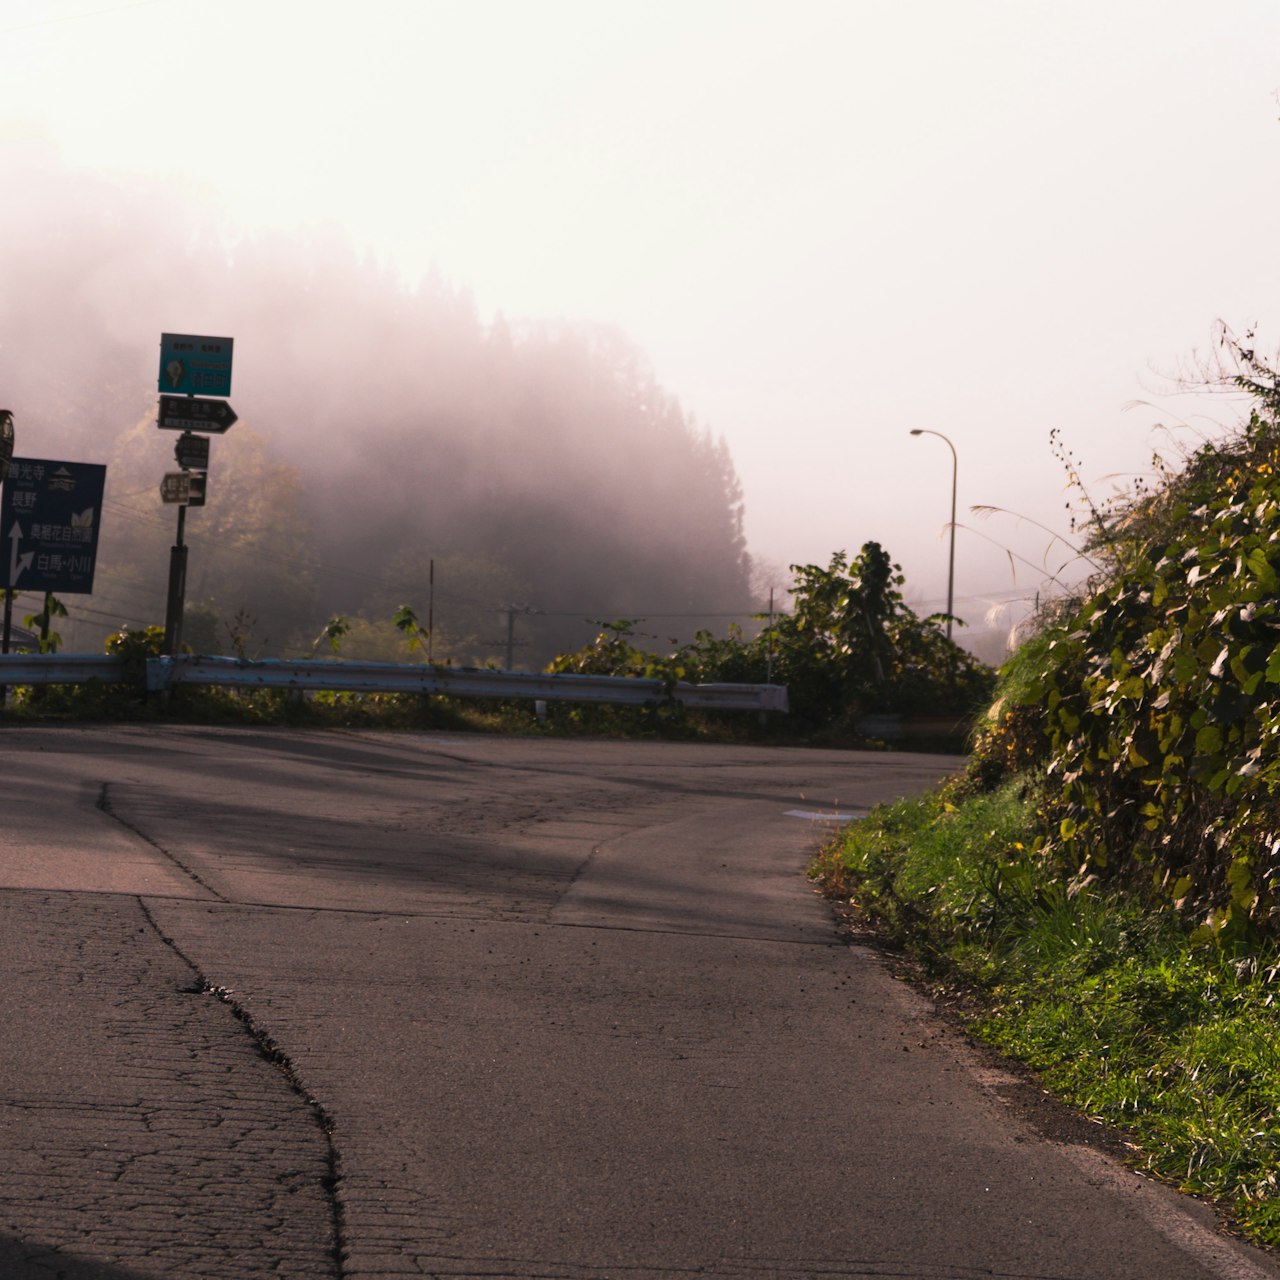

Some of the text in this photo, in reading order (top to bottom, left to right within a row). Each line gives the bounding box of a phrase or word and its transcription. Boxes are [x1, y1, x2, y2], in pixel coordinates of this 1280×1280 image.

[8, 463, 45, 480] 善光寺
[11, 491, 37, 509] 長野
[30, 524, 94, 543] 奥裾花自然園
[37, 554, 91, 573] 白馬・小川
